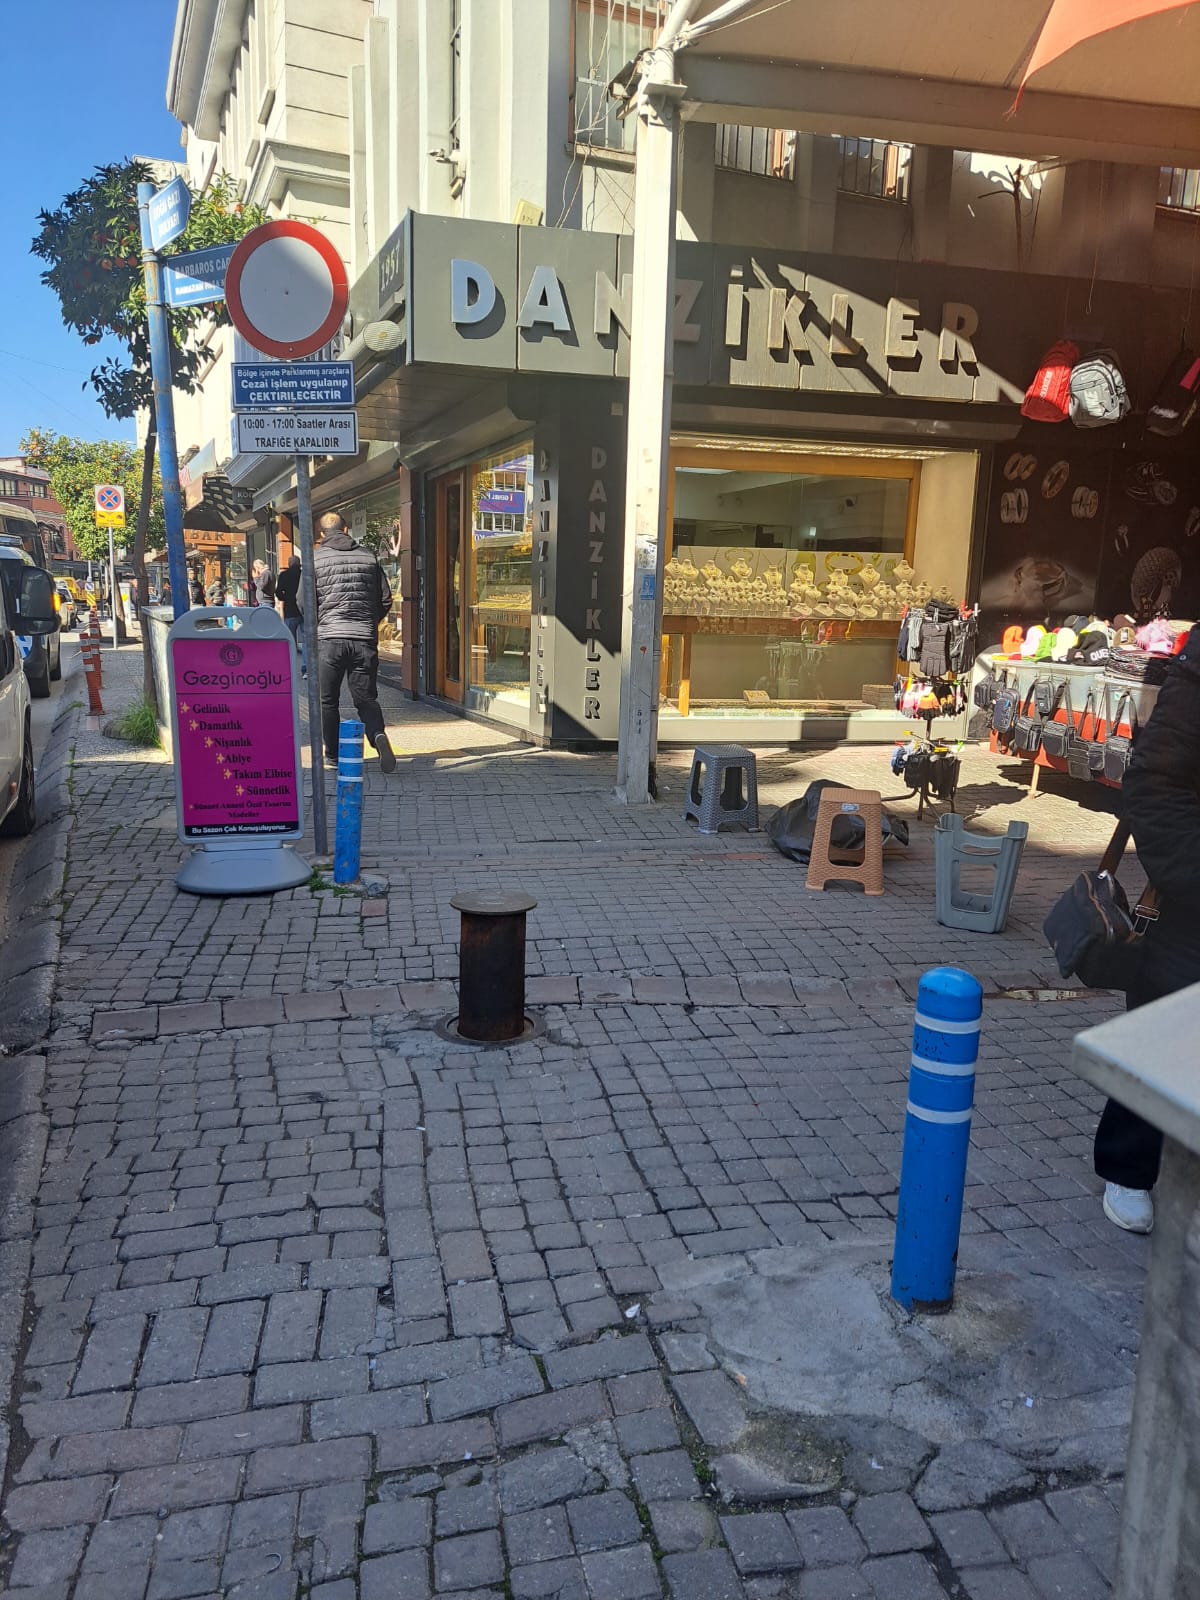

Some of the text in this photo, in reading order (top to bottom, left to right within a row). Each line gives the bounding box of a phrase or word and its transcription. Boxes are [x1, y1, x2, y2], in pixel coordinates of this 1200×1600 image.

[174, 259, 214, 280] BARBAROS
[451, 257, 979, 364] DANZİKLER
[237, 367, 350, 379] Bölge içinde Parklanmış araçlara
[241, 378, 348, 390] Cezai işlem uygulanıp
[243, 418, 265, 429] 10:00
[272, 418, 295, 429] 17:00
[296, 418, 327, 429] Saatler
[329, 418, 351, 429] Arası
[293, 437, 340, 448] KAPALIDIR
[584, 446, 608, 719] DANZİKLER
[183, 670, 283, 690] Gezginoğlu
[192, 703, 231, 714] Gelinlik
[200, 720, 242, 731] Damatlık
[214, 737, 253, 749] Nişanlık
[224, 753, 252, 765] Abiye
[232, 768, 292, 779] Takım Elbise
[247, 785, 290, 795] Sünnetlik
[246, 800, 263, 808] Özel
[264, 800, 292, 808] Tasarım
[223, 826, 237, 834] Çok
